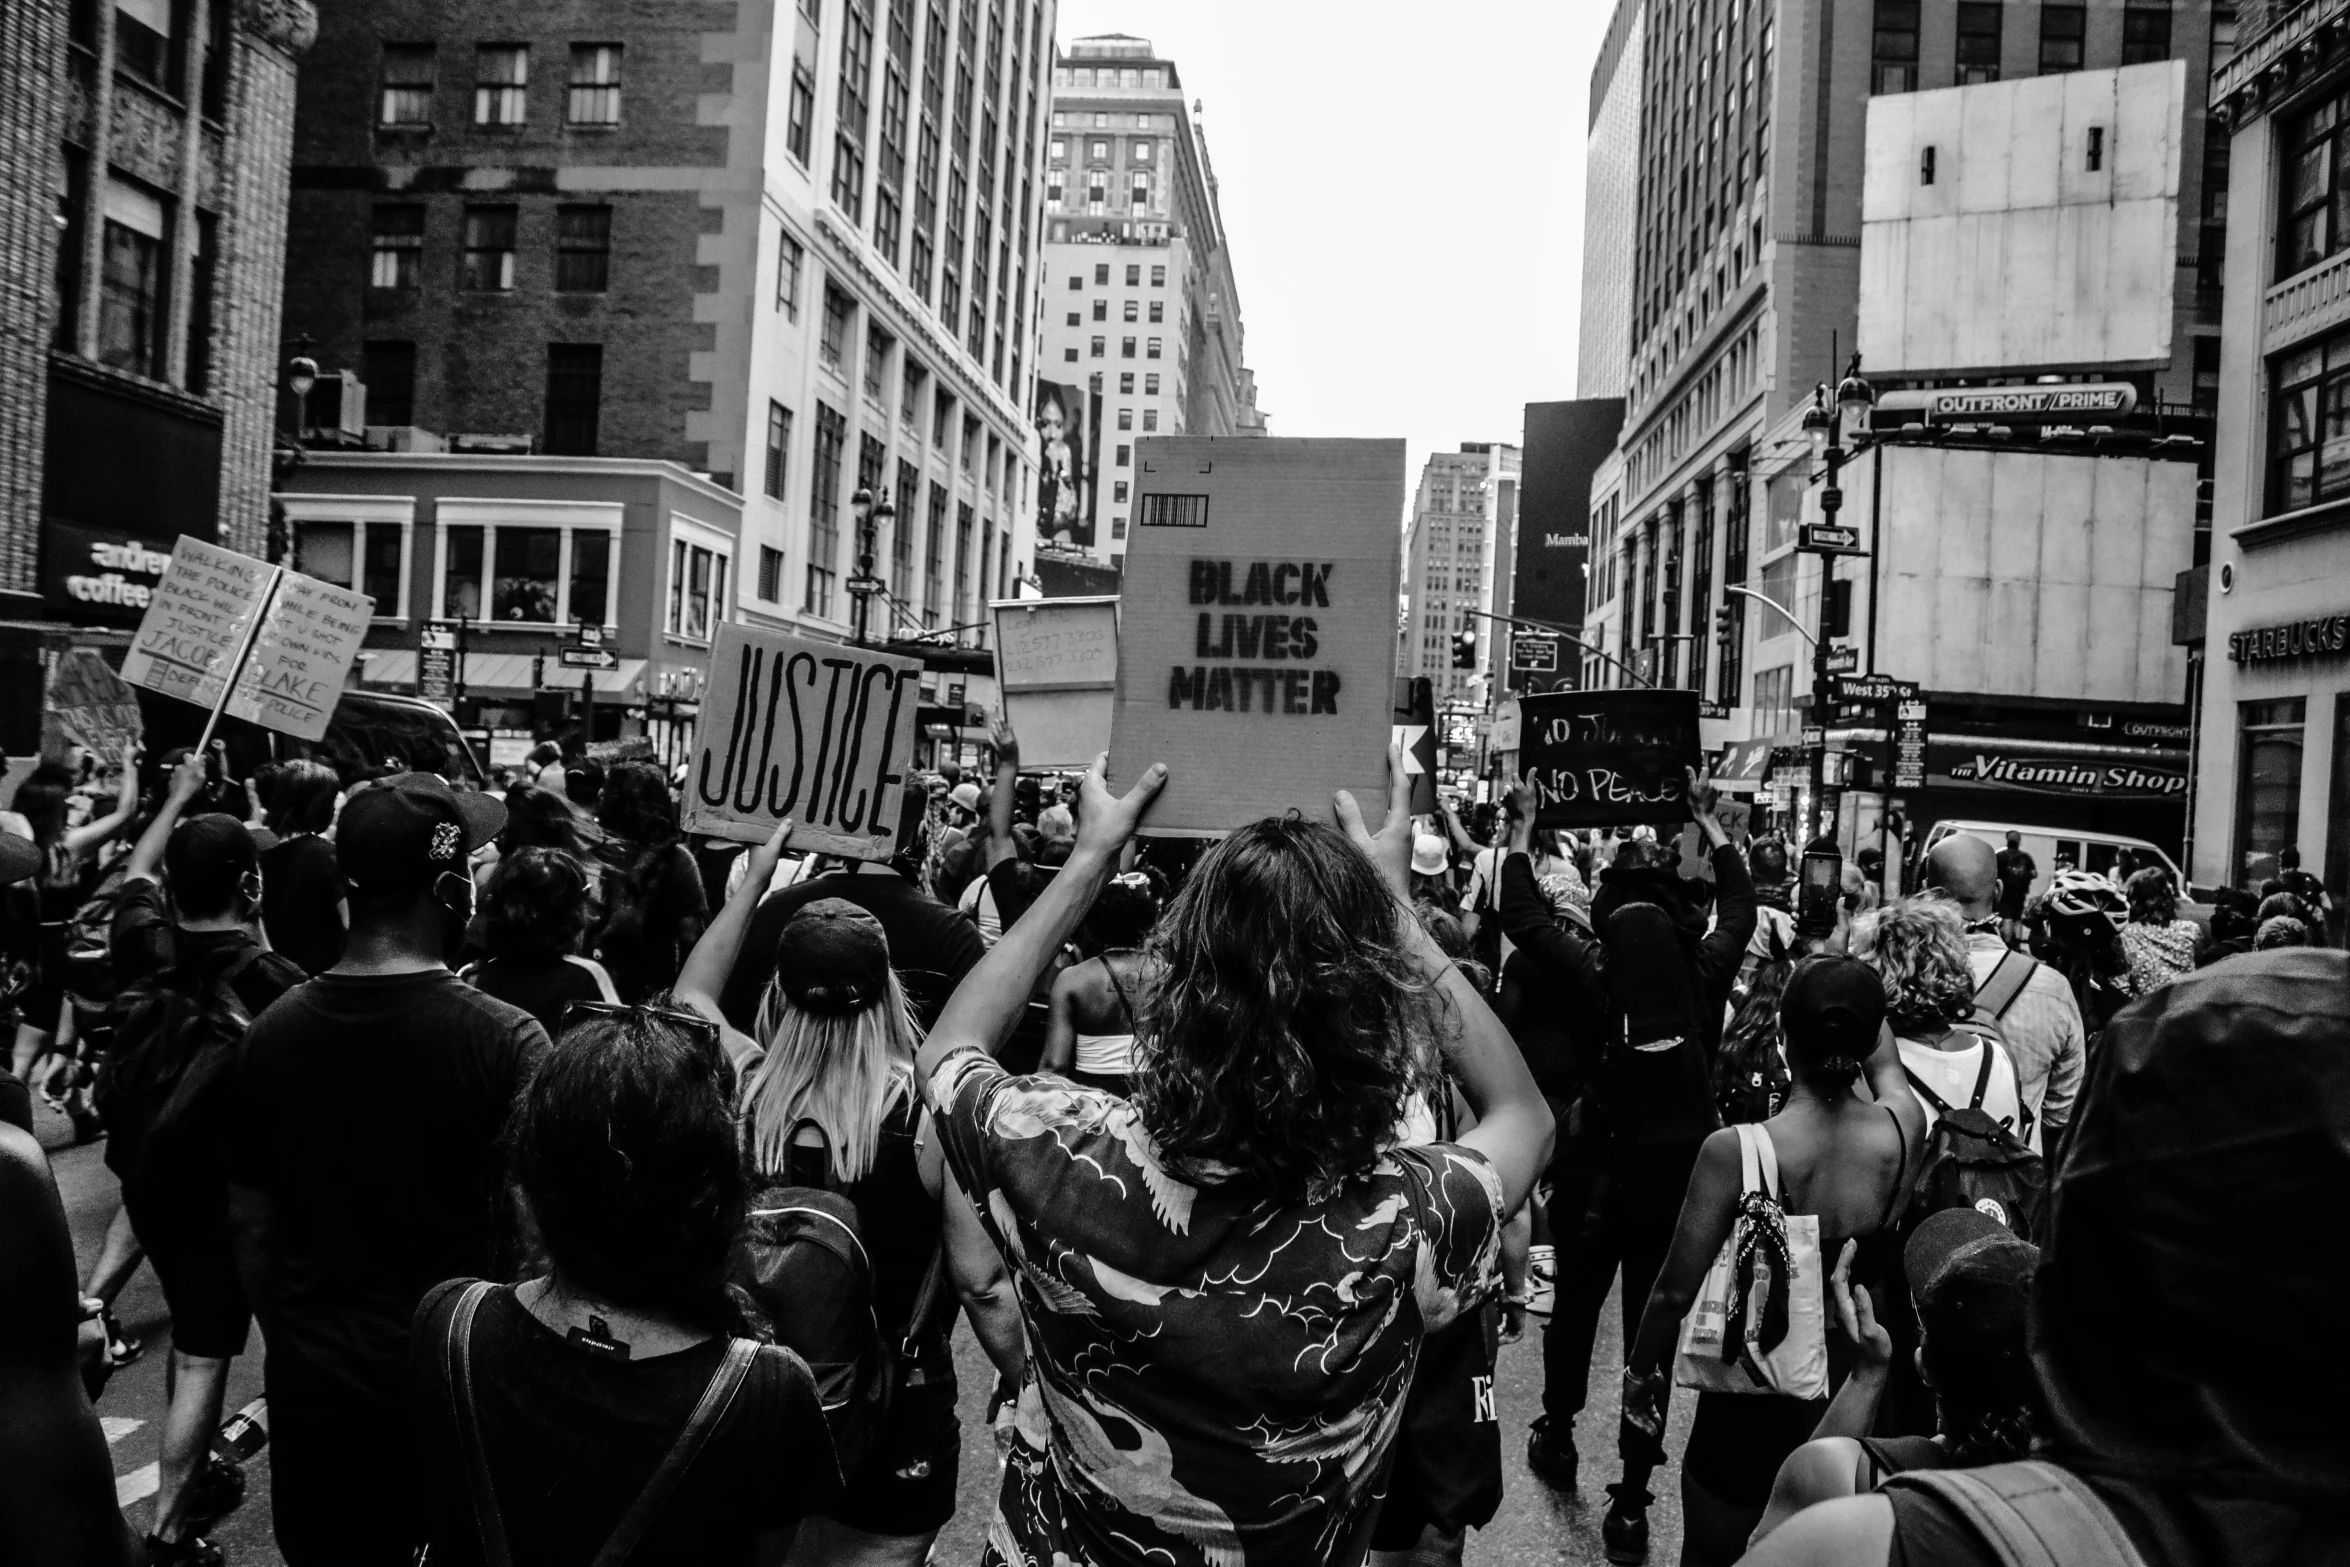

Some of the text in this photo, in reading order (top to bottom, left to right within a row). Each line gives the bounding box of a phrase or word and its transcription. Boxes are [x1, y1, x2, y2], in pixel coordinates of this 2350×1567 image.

[2058, 392, 2117, 408] PRIME
[1544, 532, 1589, 547] Mamba
[66, 573, 151, 608] coffee
[164, 581, 209, 602] BLACK
[175, 564, 200, 581] THE
[206, 576, 255, 602] POLICE
[321, 614, 361, 635] BEING
[1188, 560, 1334, 607] BLACK
[156, 599, 173, 611] IN
[178, 603, 224, 626] FRONT
[164, 616, 233, 648] JUSTICE
[1196, 612, 1318, 660] LIVES
[2227, 616, 2347, 661] STARBUCKS
[1168, 665, 1342, 715] MATTER
[1842, 682, 1873, 697] West
[699, 643, 919, 837] JUSTICE
[1534, 768, 1579, 809] NO
[1975, 755, 2097, 785] Vitamin
[2103, 768, 2187, 793] Shop
